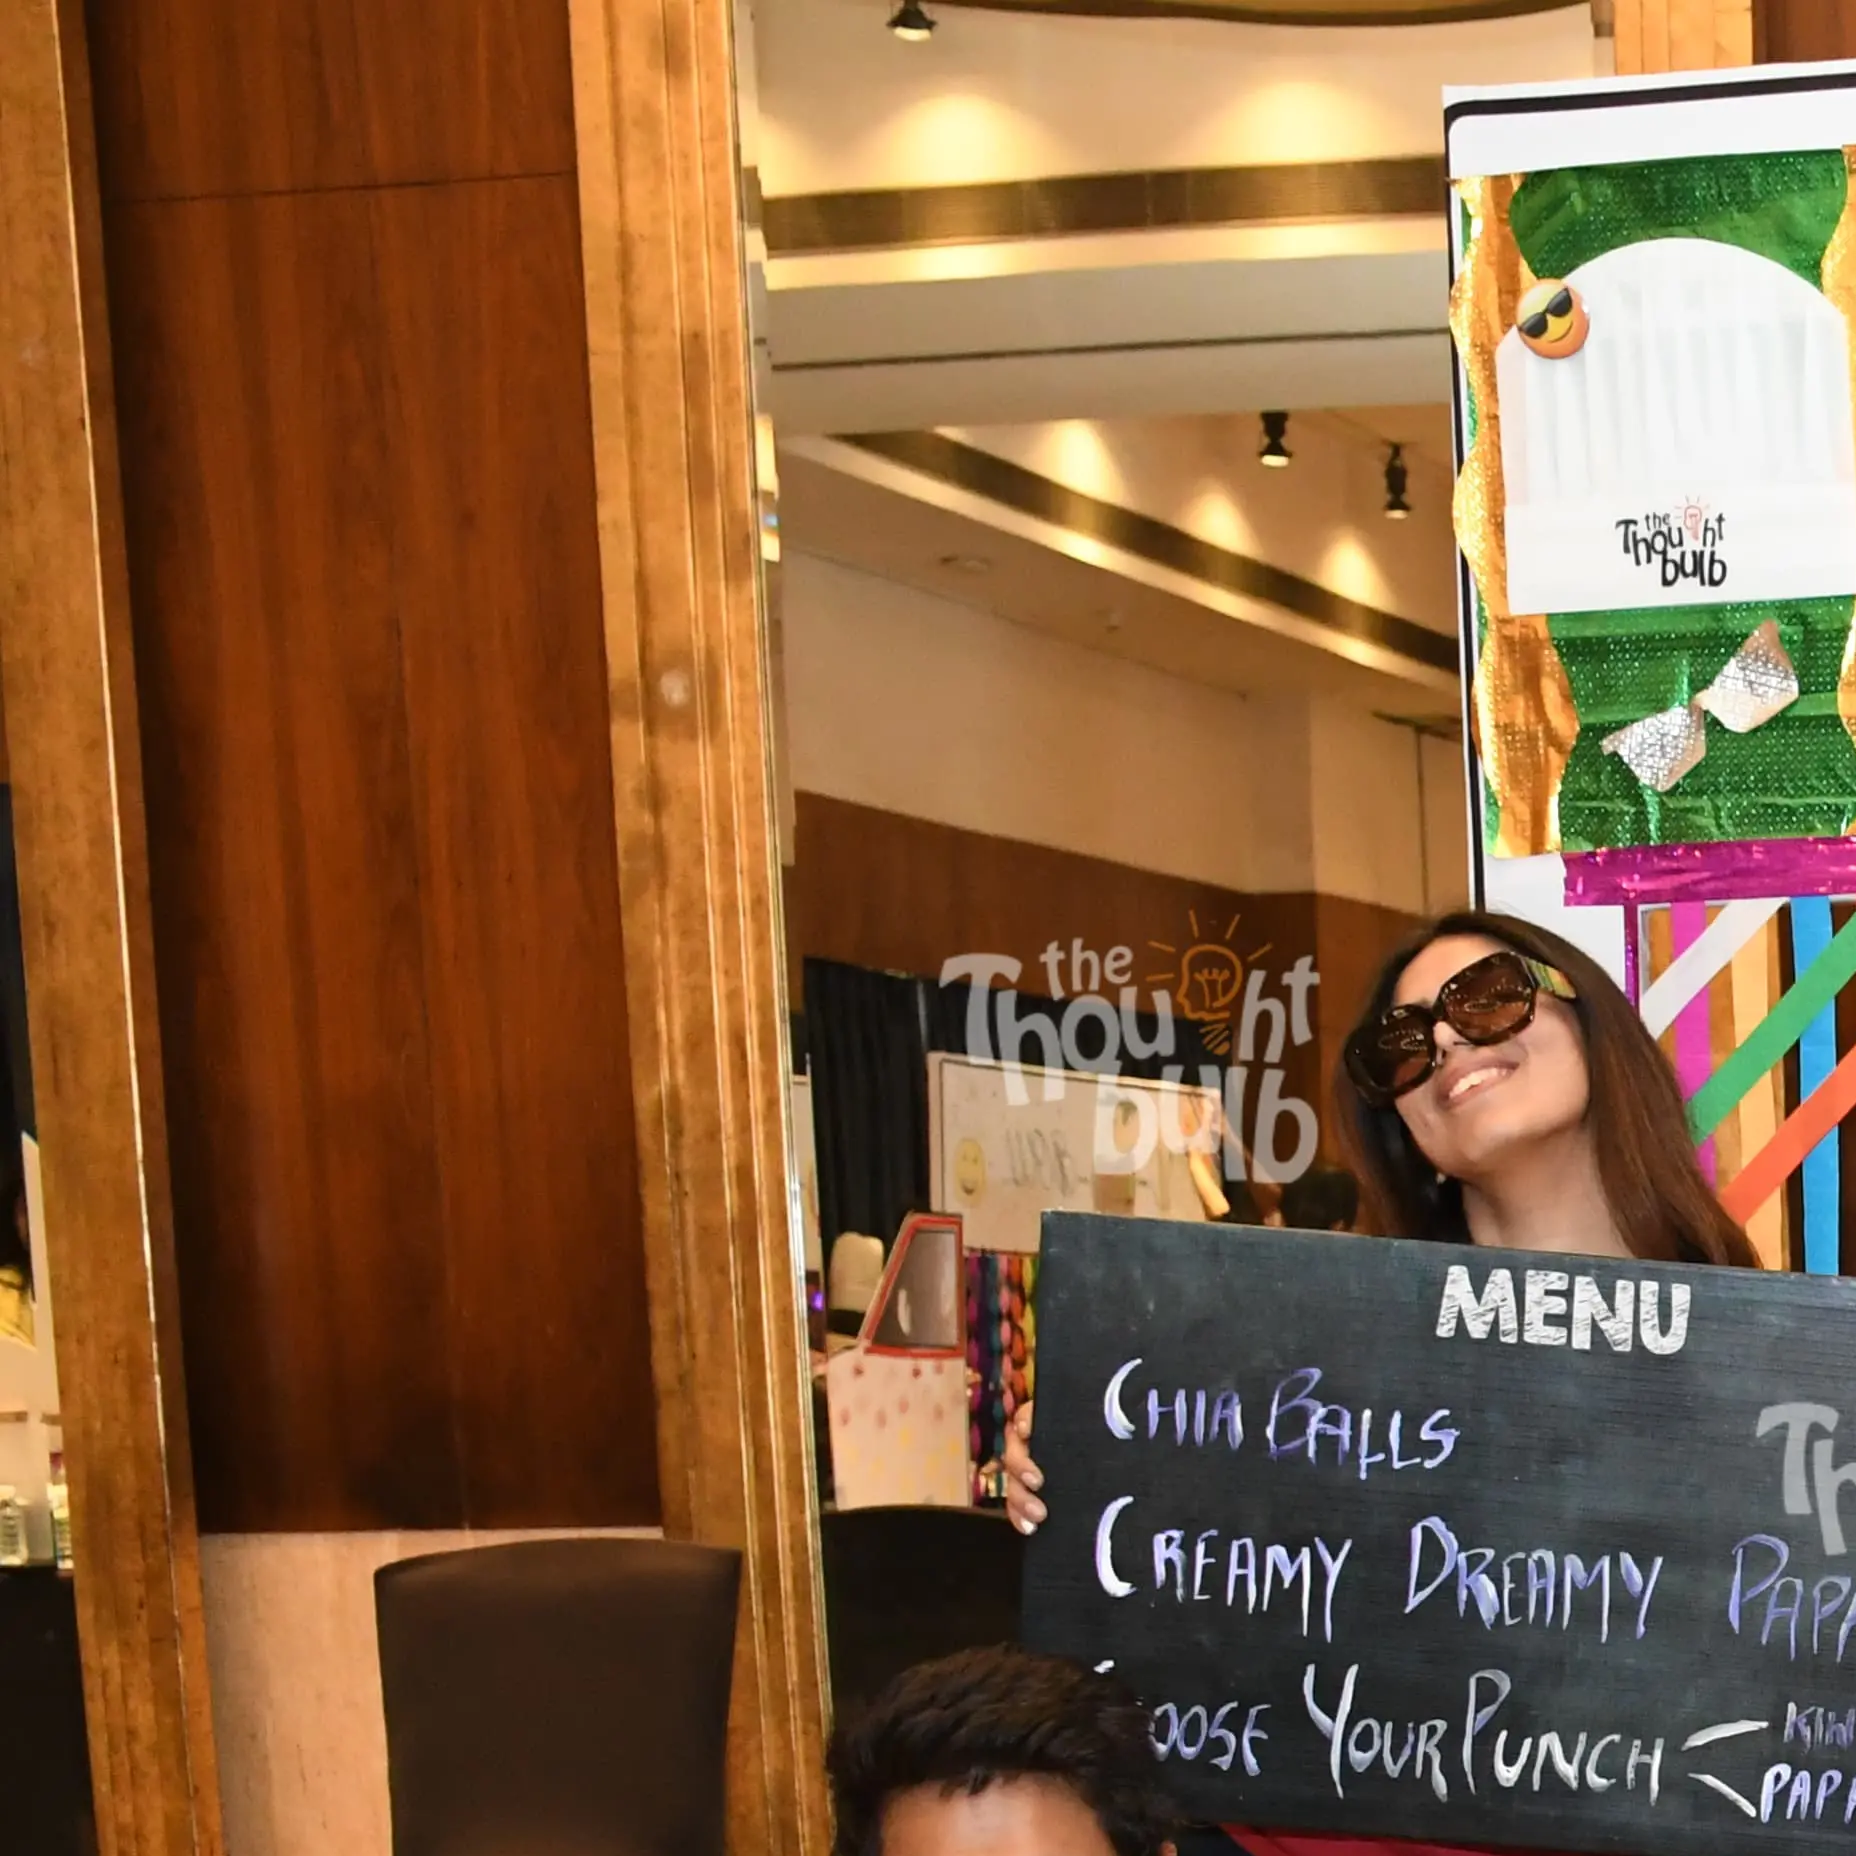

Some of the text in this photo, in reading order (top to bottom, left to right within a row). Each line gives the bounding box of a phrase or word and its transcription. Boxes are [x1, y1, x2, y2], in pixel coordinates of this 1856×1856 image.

[1645, 512, 1672, 531] the
[1662, 546, 1728, 588] bulb
[1436, 1264, 1691, 1354] MENU
[1101, 1358, 1459, 1480] CHIA BALLS
[1094, 1495, 1352, 1644] CREAMY
[1403, 1515, 1664, 1644] DREAMY
[1302, 1661, 1448, 1803] YOUR
[1464, 1667, 1666, 1806] PUNCH
